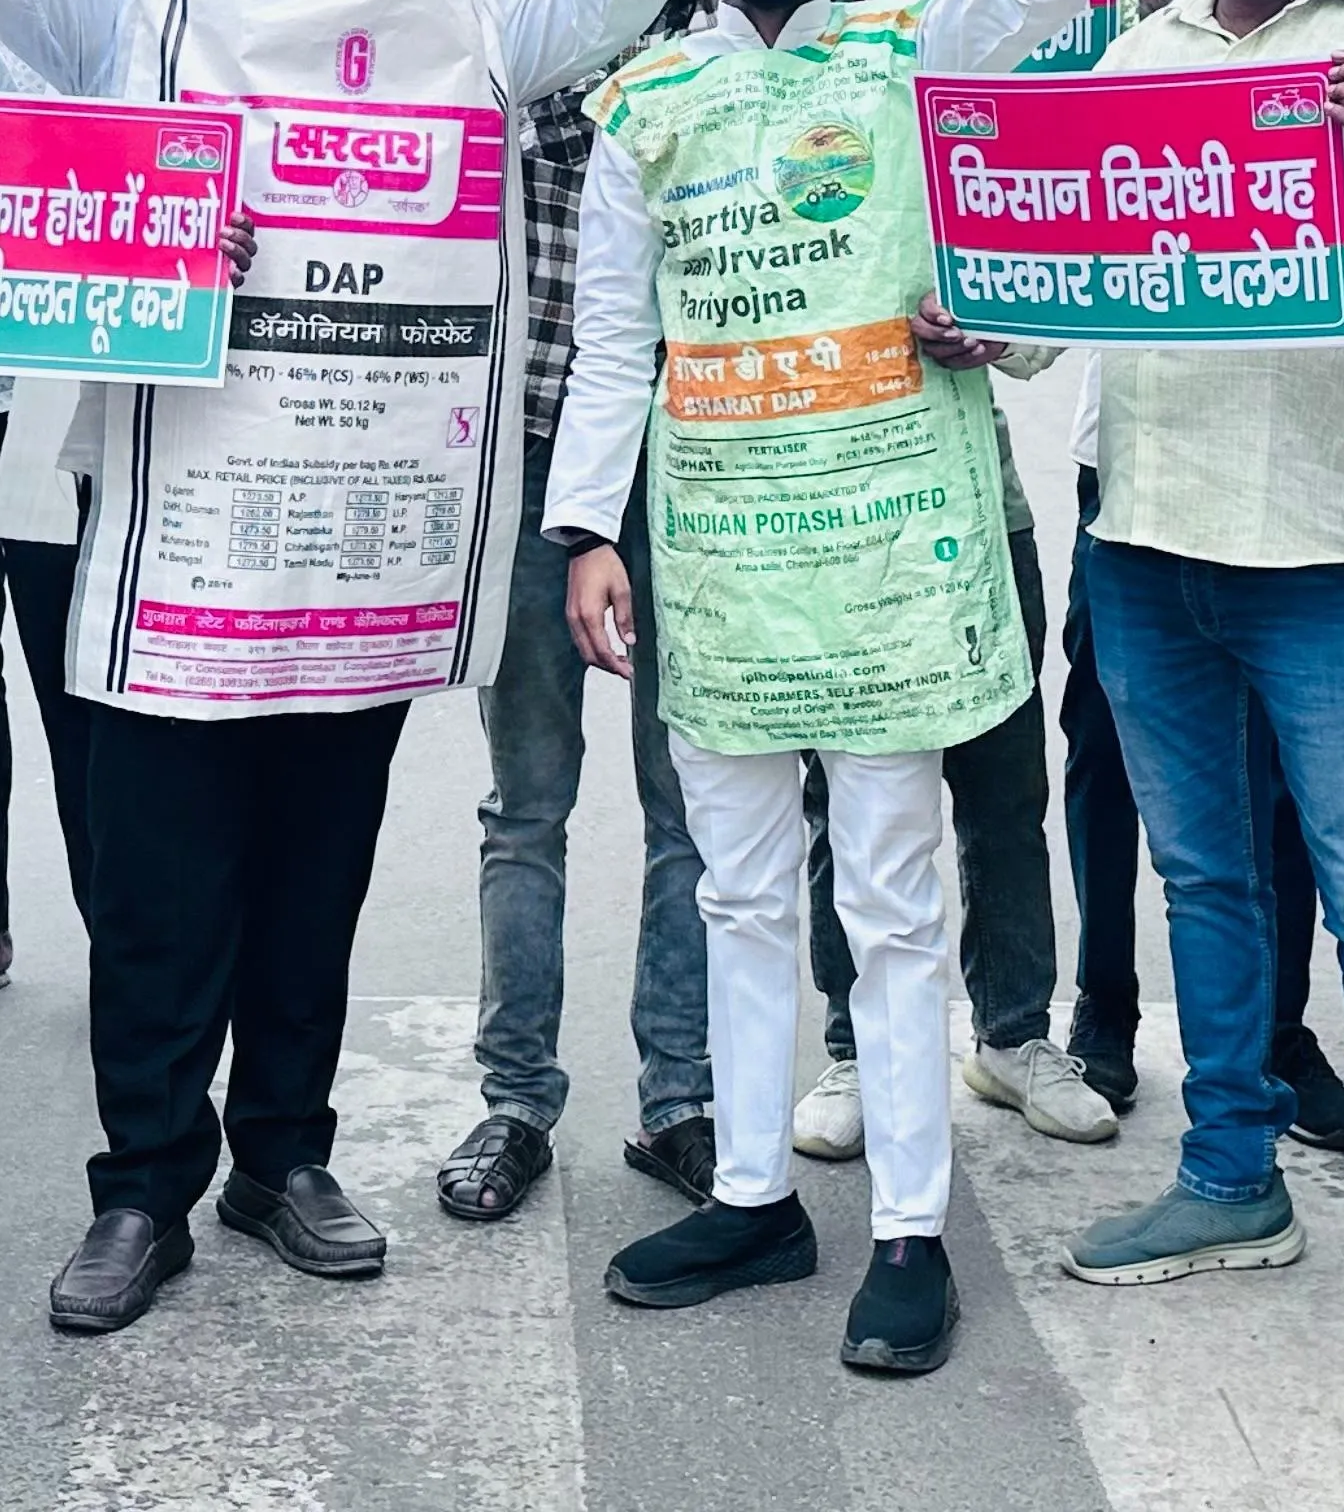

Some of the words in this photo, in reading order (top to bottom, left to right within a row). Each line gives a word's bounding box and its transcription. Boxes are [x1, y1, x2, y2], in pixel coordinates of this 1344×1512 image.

[343, 35, 369, 88] G
[282, 121, 424, 170] सरदार
[949, 143, 1092, 223] किसान
[1099, 139, 1236, 222] विरोधी
[1244, 157, 1318, 221] यह
[45, 168, 104, 247] होश
[111, 171, 146, 245] में
[142, 176, 221, 251] आओ
[305, 259, 384, 296] DAP
[953, 246, 1095, 308] सरकार
[1100, 229, 1192, 314] नहीं
[1195, 222, 1330, 309] चलेगी
[84, 276, 130, 355] दूर
[129, 257, 191, 331] करो
[679, 286, 808, 328] Pariyojna
[400, 317, 475, 345] फोस्फेट
[320, 368, 354, 386] P(CS)
[731, 345, 766, 383] डी
[772, 350, 803, 381] ए
[279, 396, 316, 410] Gross
[339, 399, 370, 412] 50.12
[372, 399, 386, 414] kg
[294, 414, 316, 427] Net
[339, 416, 353, 428] 50
[355, 416, 369, 430] kg
[683, 394, 765, 418] BHARAT
[771, 388, 818, 414] DAP
[676, 511, 748, 537] INDIAN
[755, 508, 844, 535] POTASH
[853, 486, 947, 527] LIMITED
[915, 671, 952, 688] INDIA
